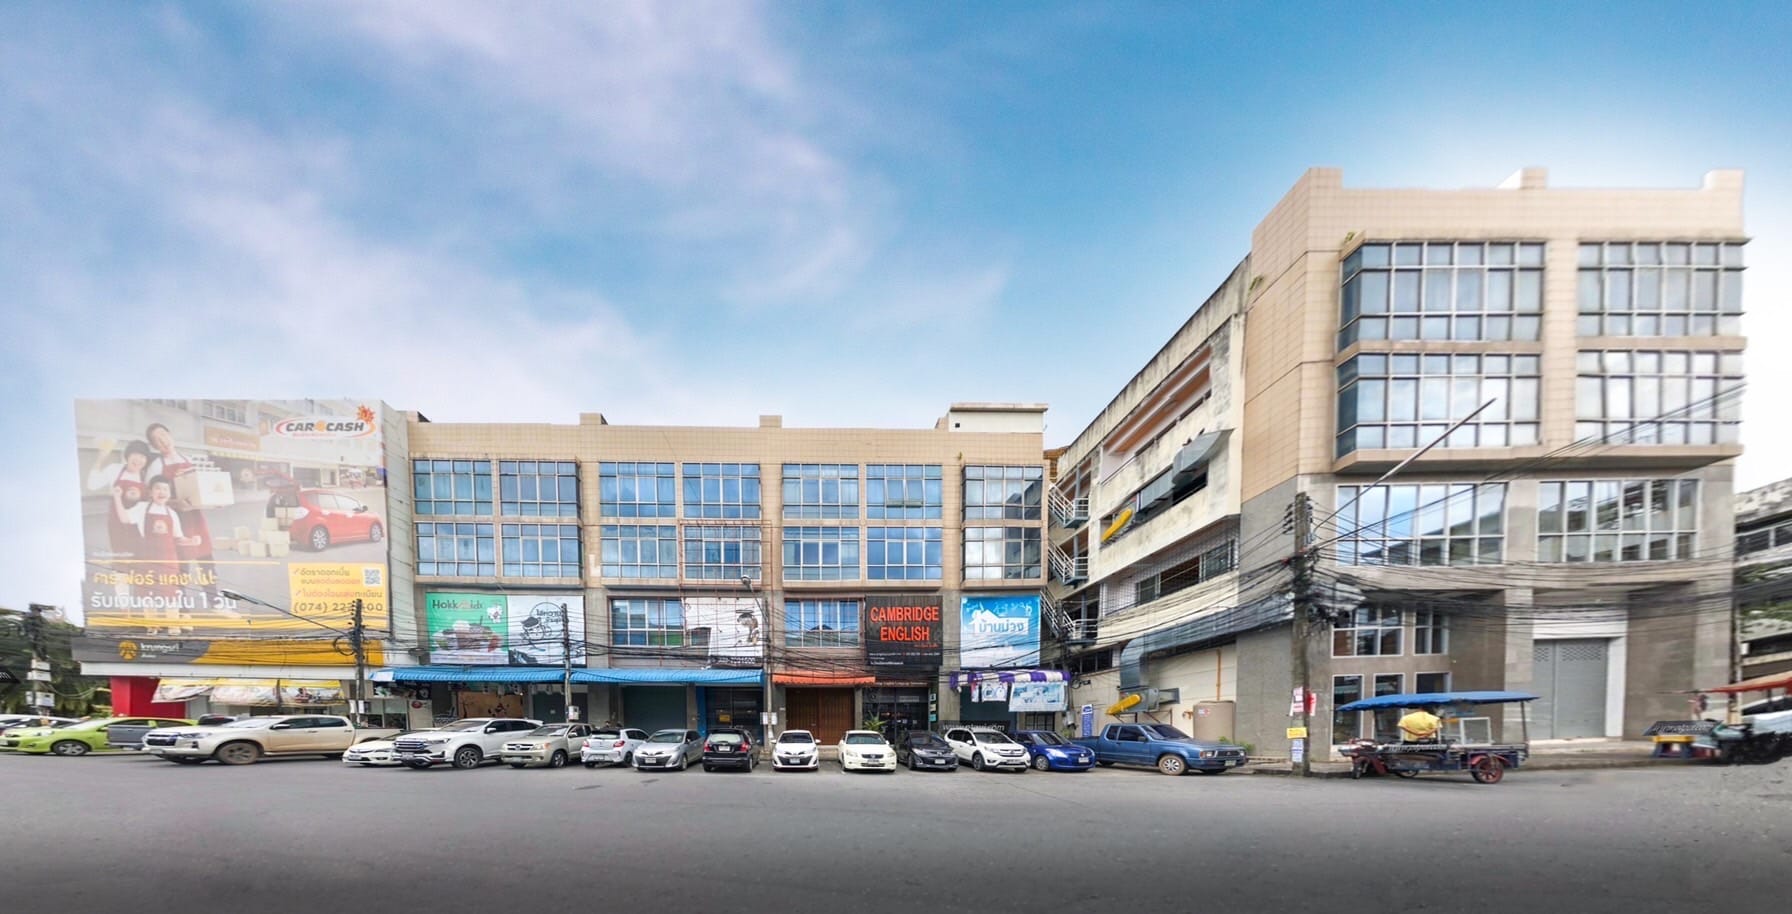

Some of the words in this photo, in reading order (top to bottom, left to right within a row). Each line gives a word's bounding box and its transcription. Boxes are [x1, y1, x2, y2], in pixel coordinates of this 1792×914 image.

[200, 592, 207, 609] 1
[294, 602, 327, 613] (074)
[870, 607, 939, 621] CAMBRIDGE
[979, 619, 1024, 633] บ้านม่วง
[881, 627, 930, 641] ENGLISH
